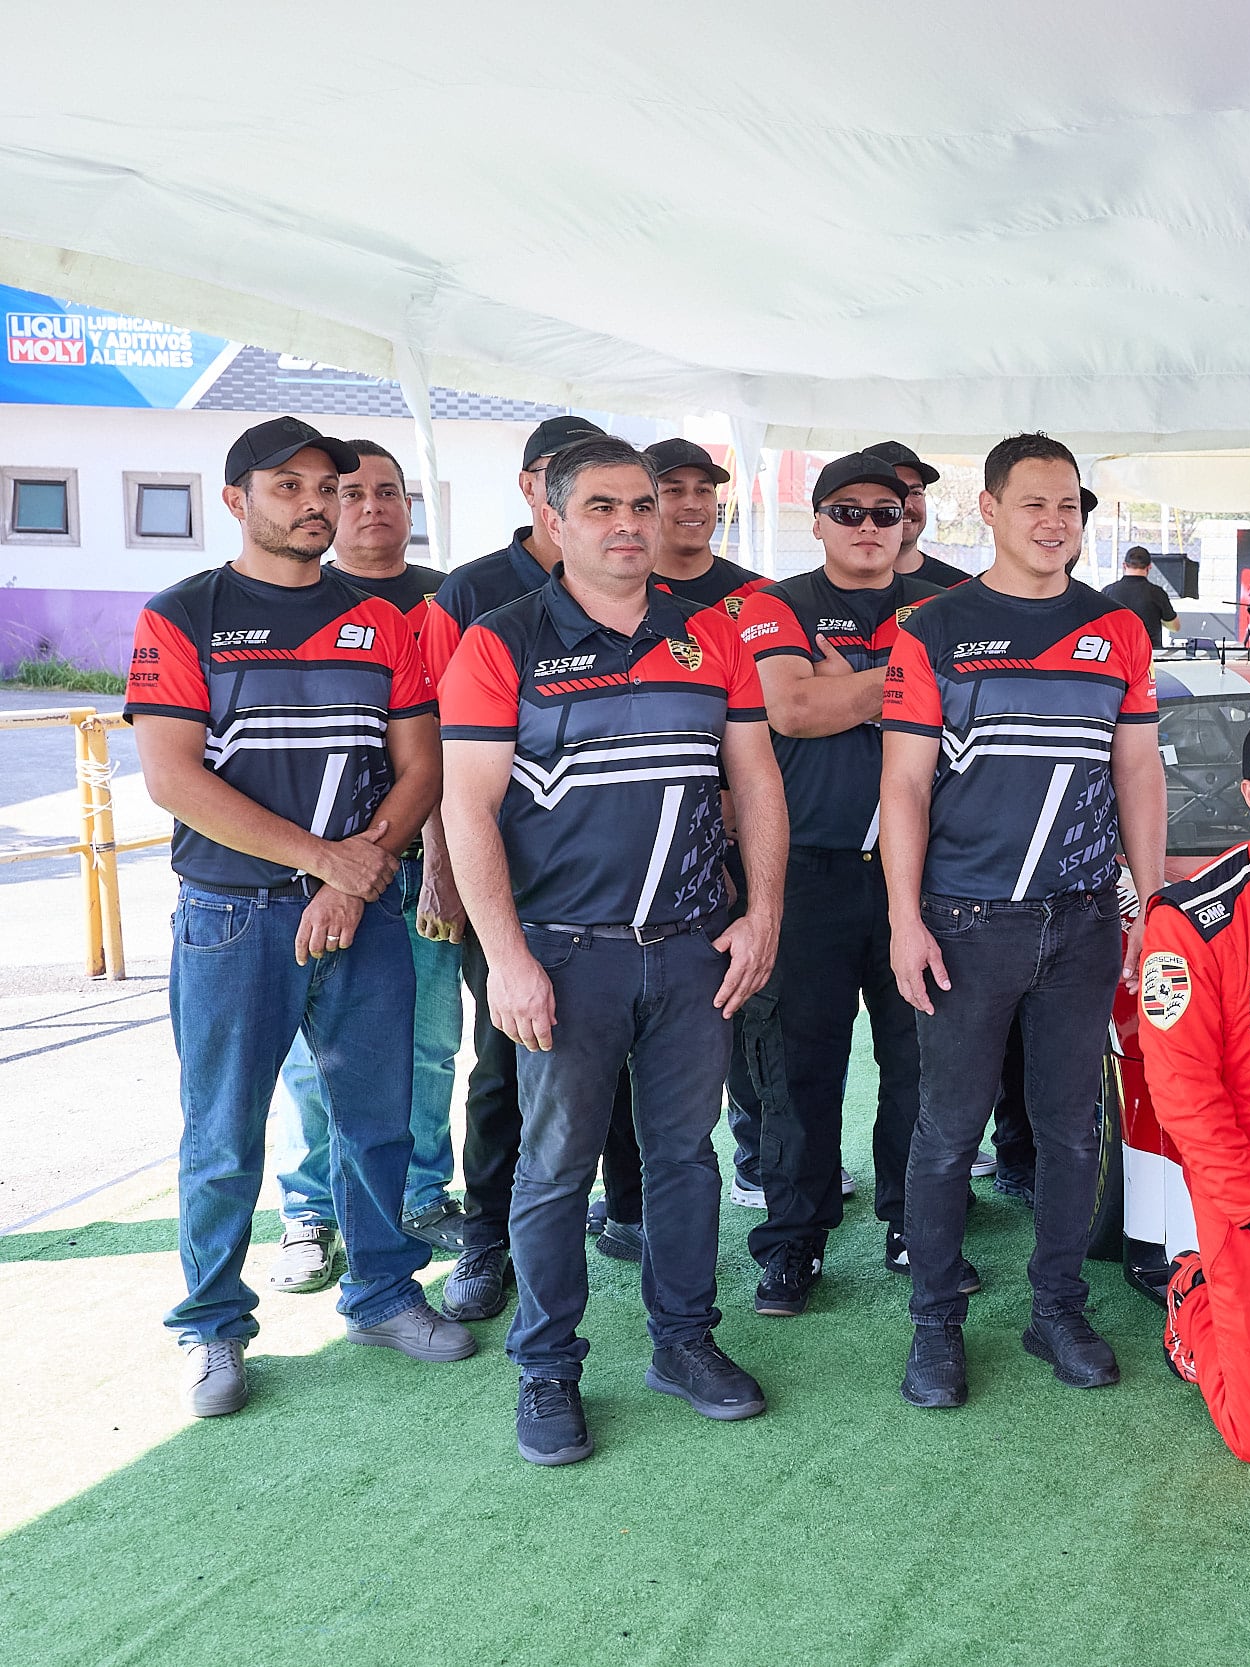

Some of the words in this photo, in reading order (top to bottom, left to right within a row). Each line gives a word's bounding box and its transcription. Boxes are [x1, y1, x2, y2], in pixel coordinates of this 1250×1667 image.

[11, 315, 81, 339] LIQUI
[12, 339, 84, 363] MOLY
[90, 332, 104, 348] Y
[105, 332, 193, 351] ADITIVOS
[90, 348, 194, 368] ALEMANES
[335, 623, 376, 651] 91
[1071, 635, 1112, 663] 91
[1198, 902, 1225, 926] OMP
